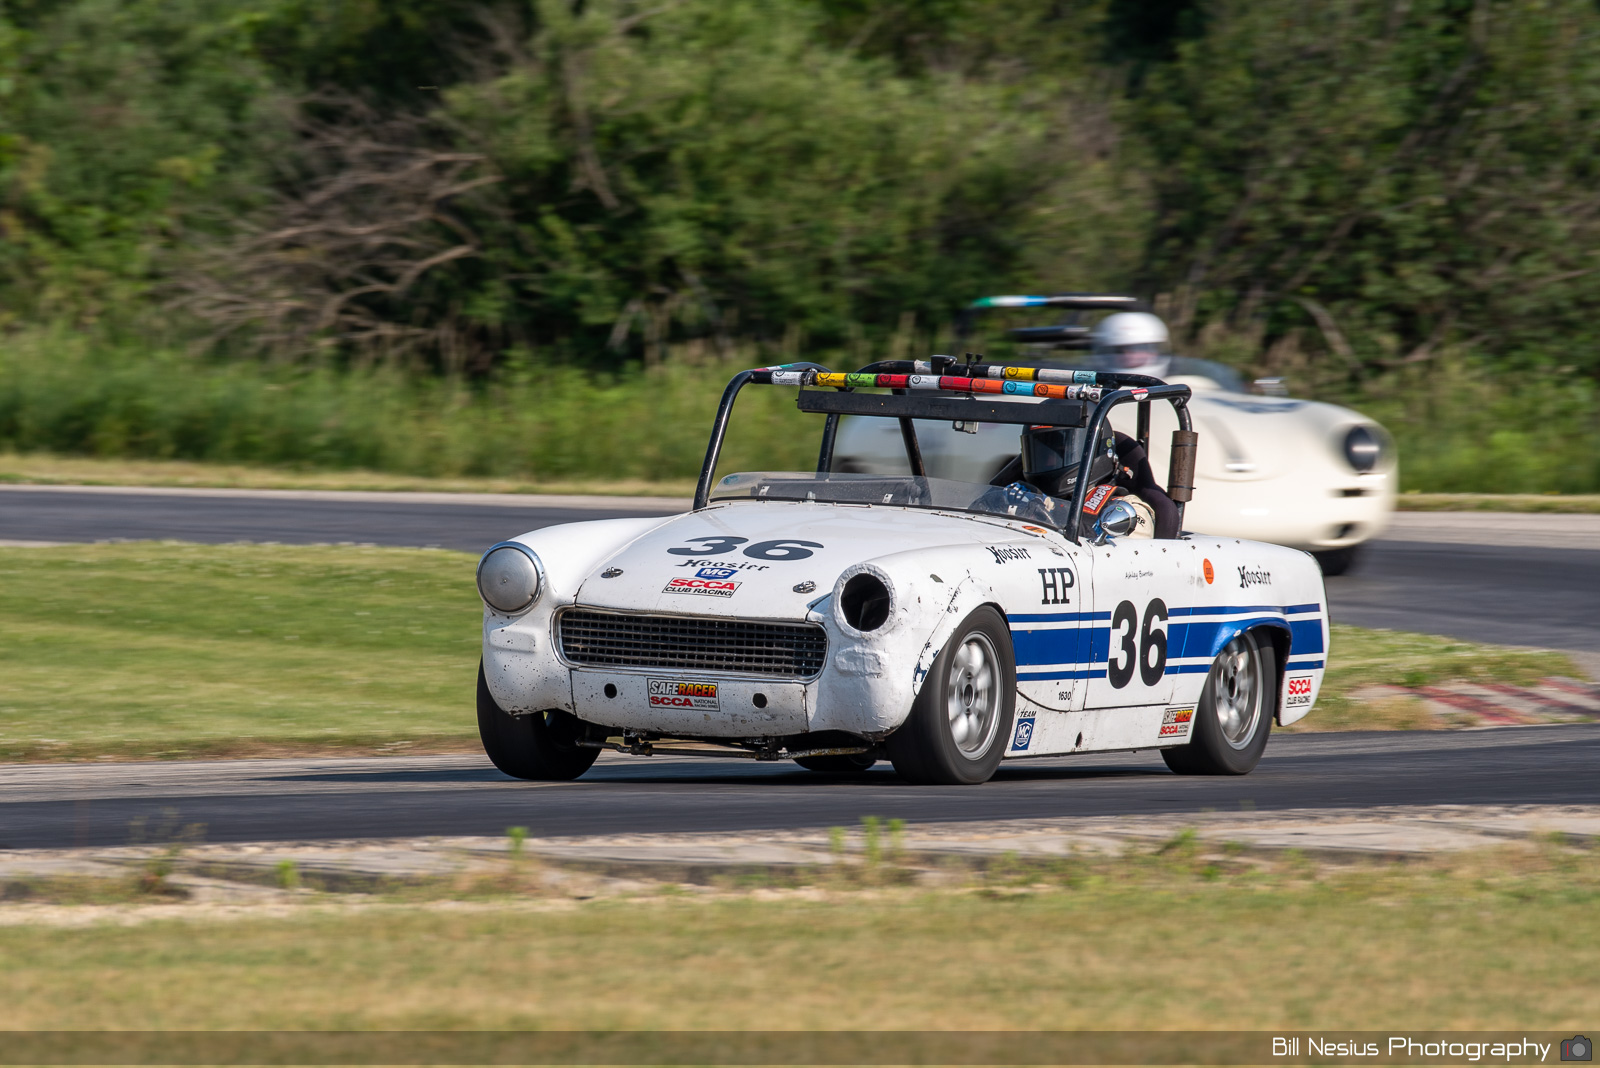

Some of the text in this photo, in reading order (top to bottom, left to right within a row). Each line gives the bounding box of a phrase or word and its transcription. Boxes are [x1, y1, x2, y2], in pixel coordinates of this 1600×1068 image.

[667, 536, 824, 560] 36
[986, 546, 1031, 564] Hoosier
[674, 559, 770, 571] Hoosier
[701, 568, 732, 576] MC
[1237, 565, 1272, 588] Hoosier
[670, 578, 735, 590] SCCA
[1038, 567, 1075, 604] HP
[693, 587, 733, 597] RACING
[1108, 598, 1169, 689] 36
[650, 681, 717, 698] SAFERACER
[1288, 679, 1311, 695] SCCA
[650, 696, 694, 707] SCCA
[1058, 691, 1071, 701] 1630
[1020, 710, 1037, 718] TEAM
[1160, 725, 1178, 735] SCCA
